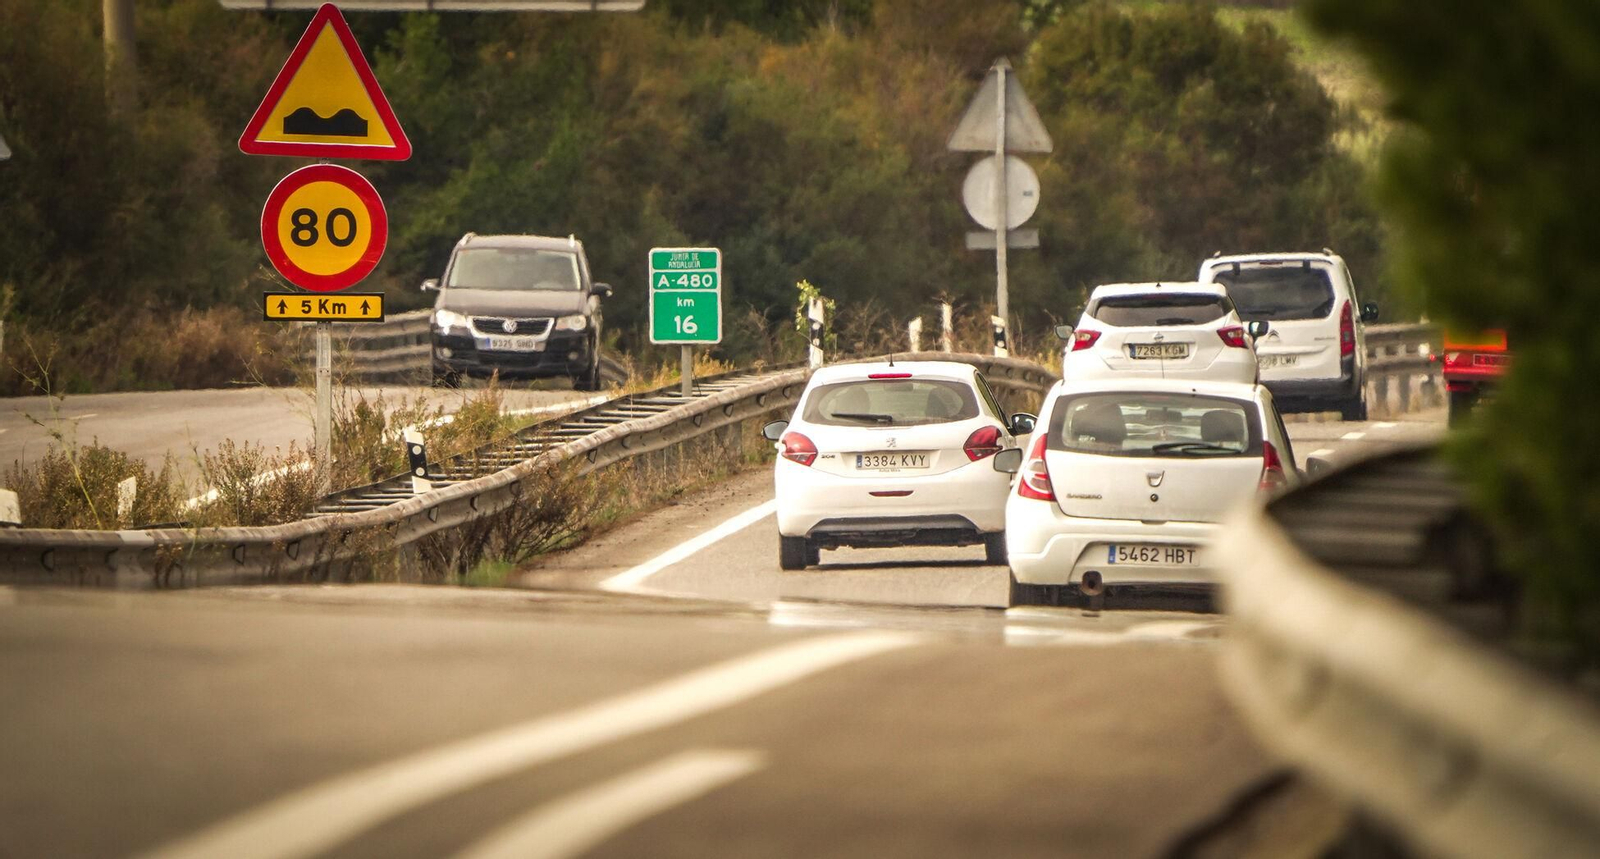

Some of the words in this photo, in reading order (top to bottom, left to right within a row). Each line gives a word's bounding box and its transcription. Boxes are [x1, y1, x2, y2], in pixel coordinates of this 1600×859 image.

[290, 207, 358, 248] 80
[670, 252, 689, 261] JUNTA
[692, 252, 699, 261] DE
[657, 274, 713, 288] A-480
[301, 300, 311, 315] 5
[319, 299, 346, 315] Km
[676, 297, 695, 307] km
[674, 315, 698, 334] 16
[1137, 346, 1162, 356] 7263
[1164, 345, 1185, 355] KGM
[864, 455, 897, 467] 3384
[901, 454, 926, 467] KVY
[1119, 547, 1160, 563] 5462
[1165, 548, 1197, 565] HBT
